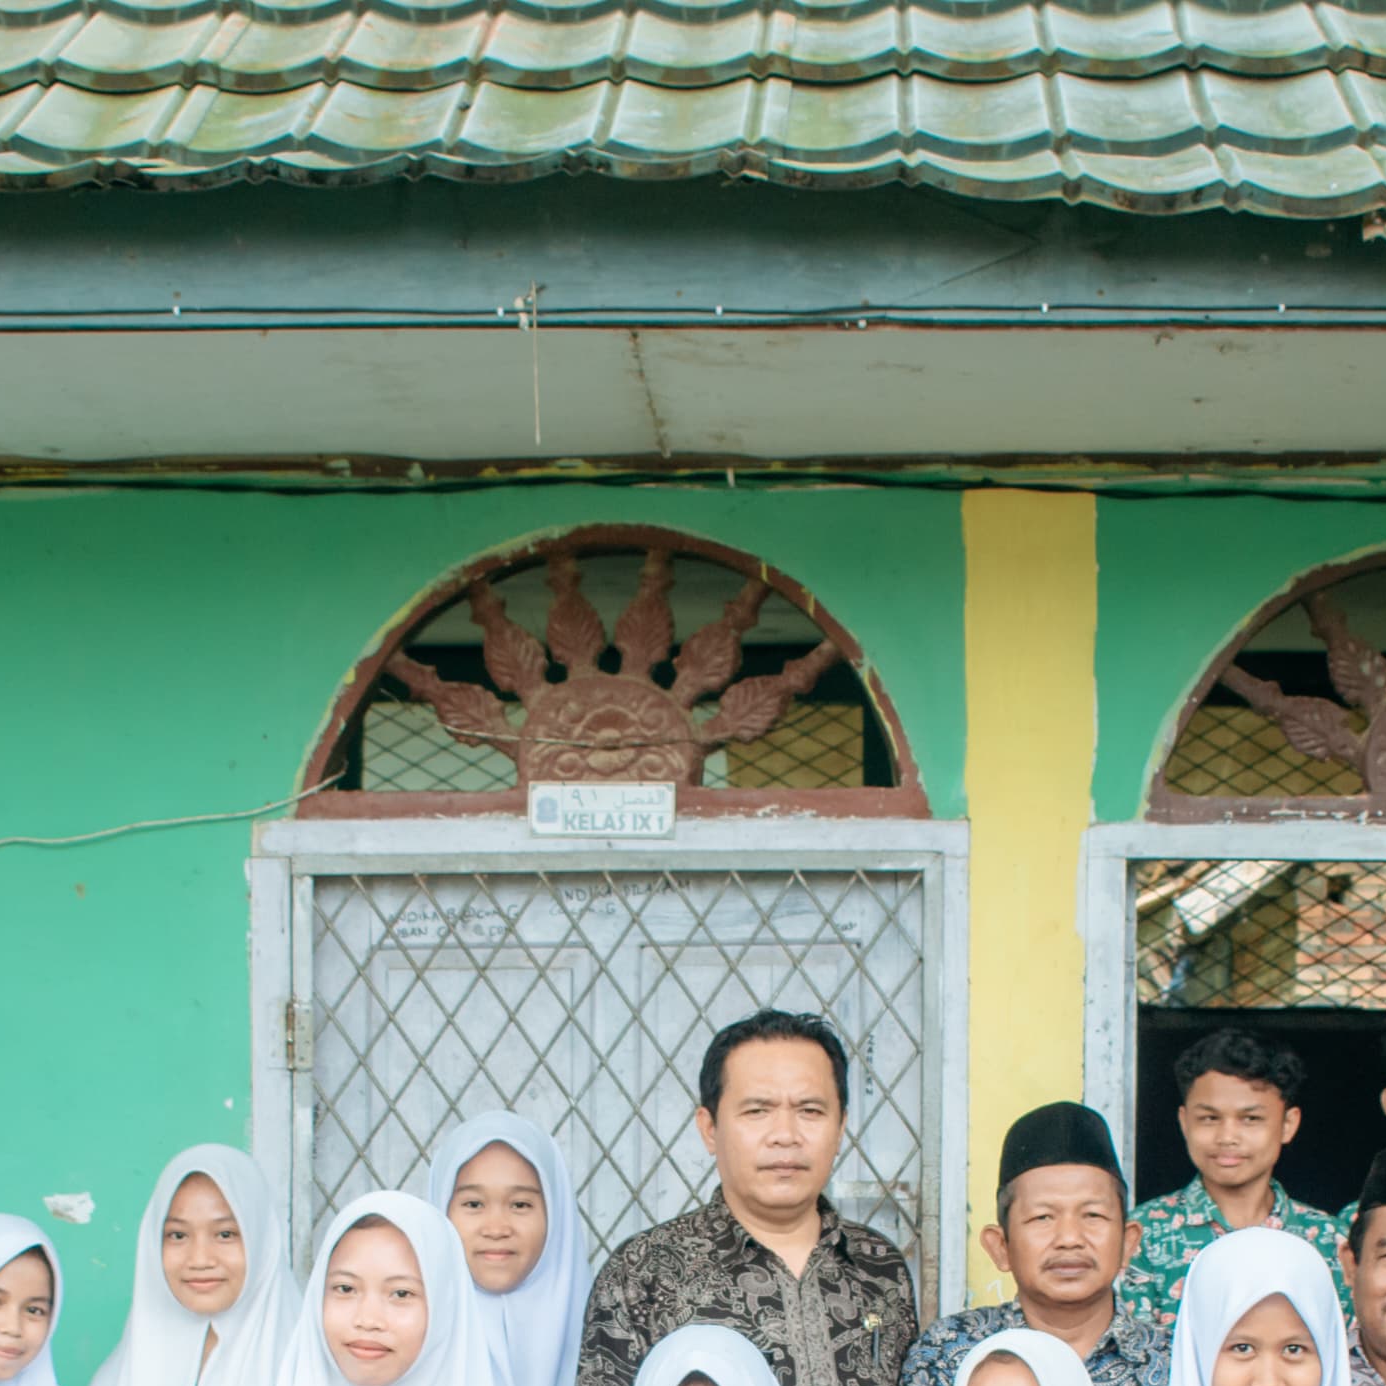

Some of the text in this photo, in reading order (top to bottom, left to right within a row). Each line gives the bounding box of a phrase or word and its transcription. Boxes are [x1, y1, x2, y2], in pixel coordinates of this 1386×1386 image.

[563, 813, 664, 831] KELAS IX 1
